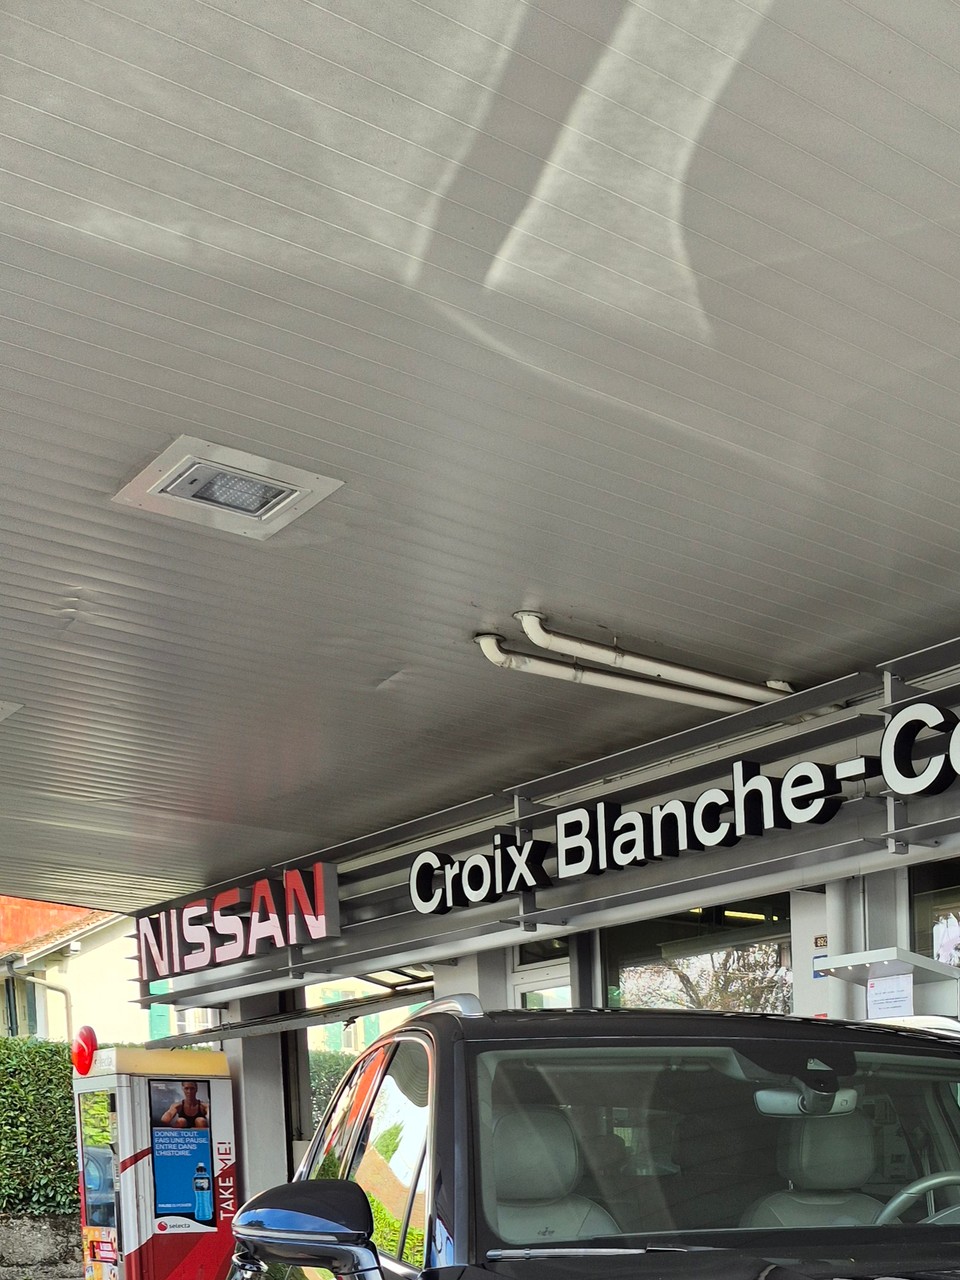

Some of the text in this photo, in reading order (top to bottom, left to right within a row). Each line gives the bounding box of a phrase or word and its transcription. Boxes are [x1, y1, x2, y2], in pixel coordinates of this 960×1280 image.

[409, 833, 540, 914] Croix
[137, 863, 329, 981] NISSAN
[217, 1142, 235, 1221] TAKE ME!
